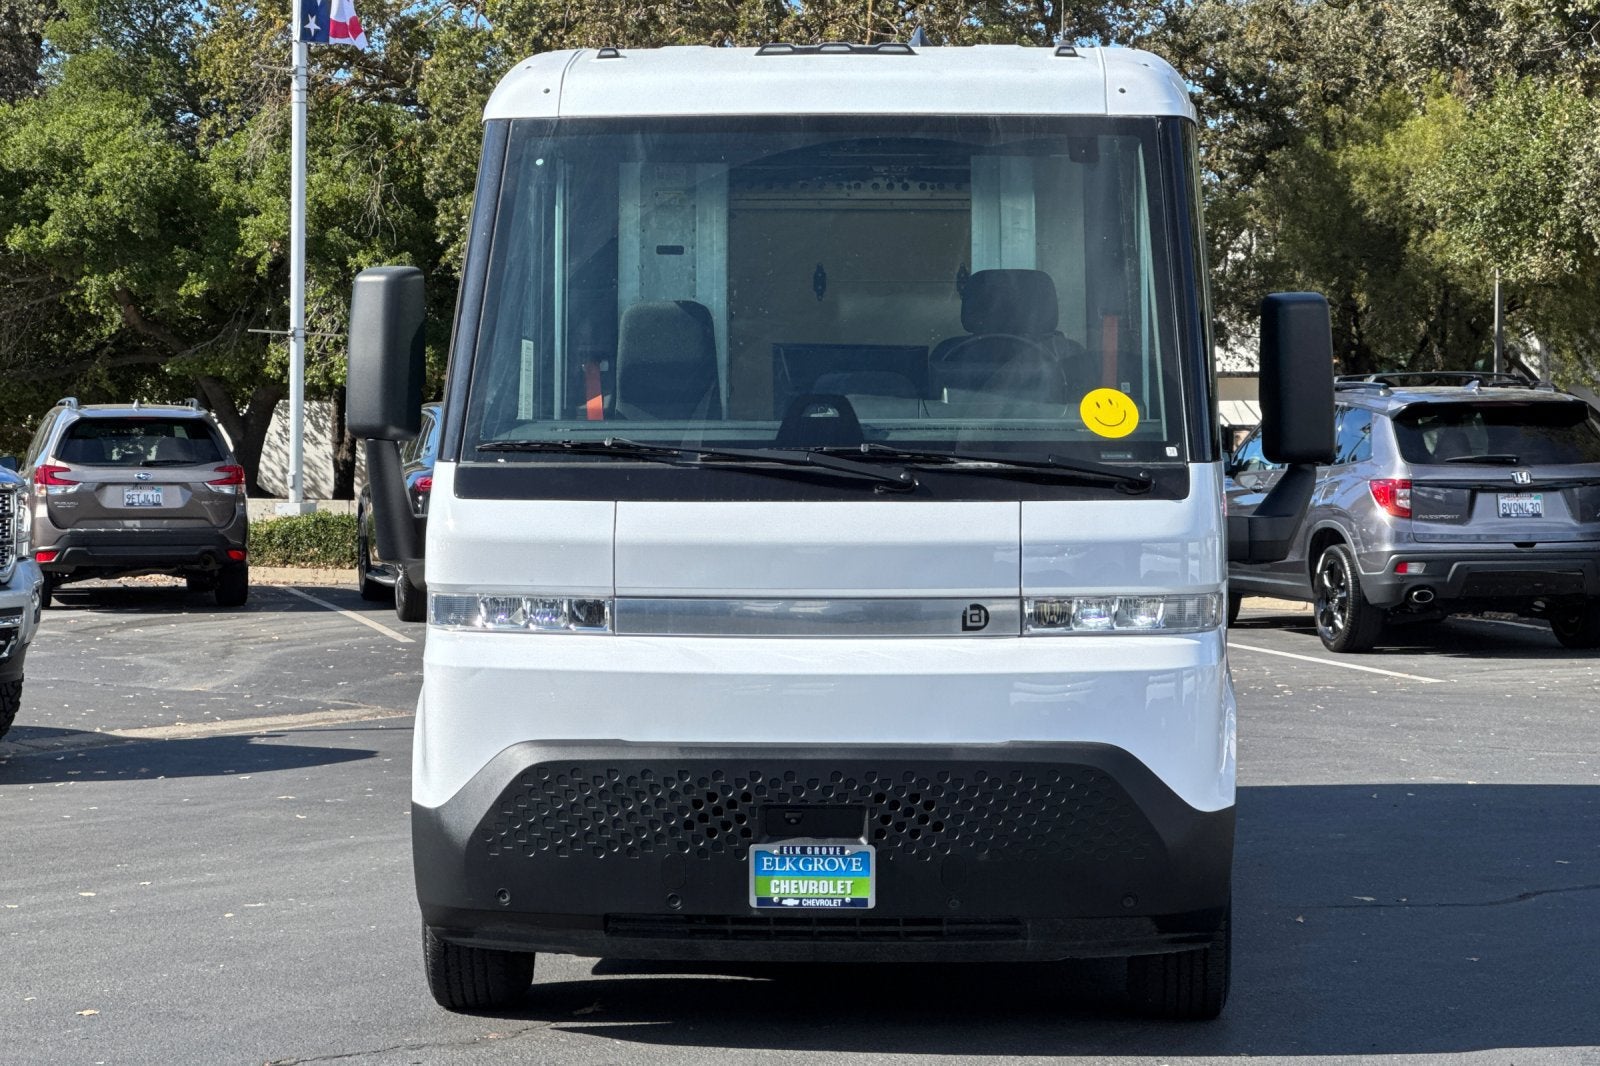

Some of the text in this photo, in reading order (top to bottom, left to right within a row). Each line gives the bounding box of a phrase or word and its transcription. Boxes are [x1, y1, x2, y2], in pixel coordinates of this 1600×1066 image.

[783, 846, 841, 855] ELK GROVE
[770, 879, 854, 895] CHEVROLET
[801, 899, 842, 907] CHEVROLET
